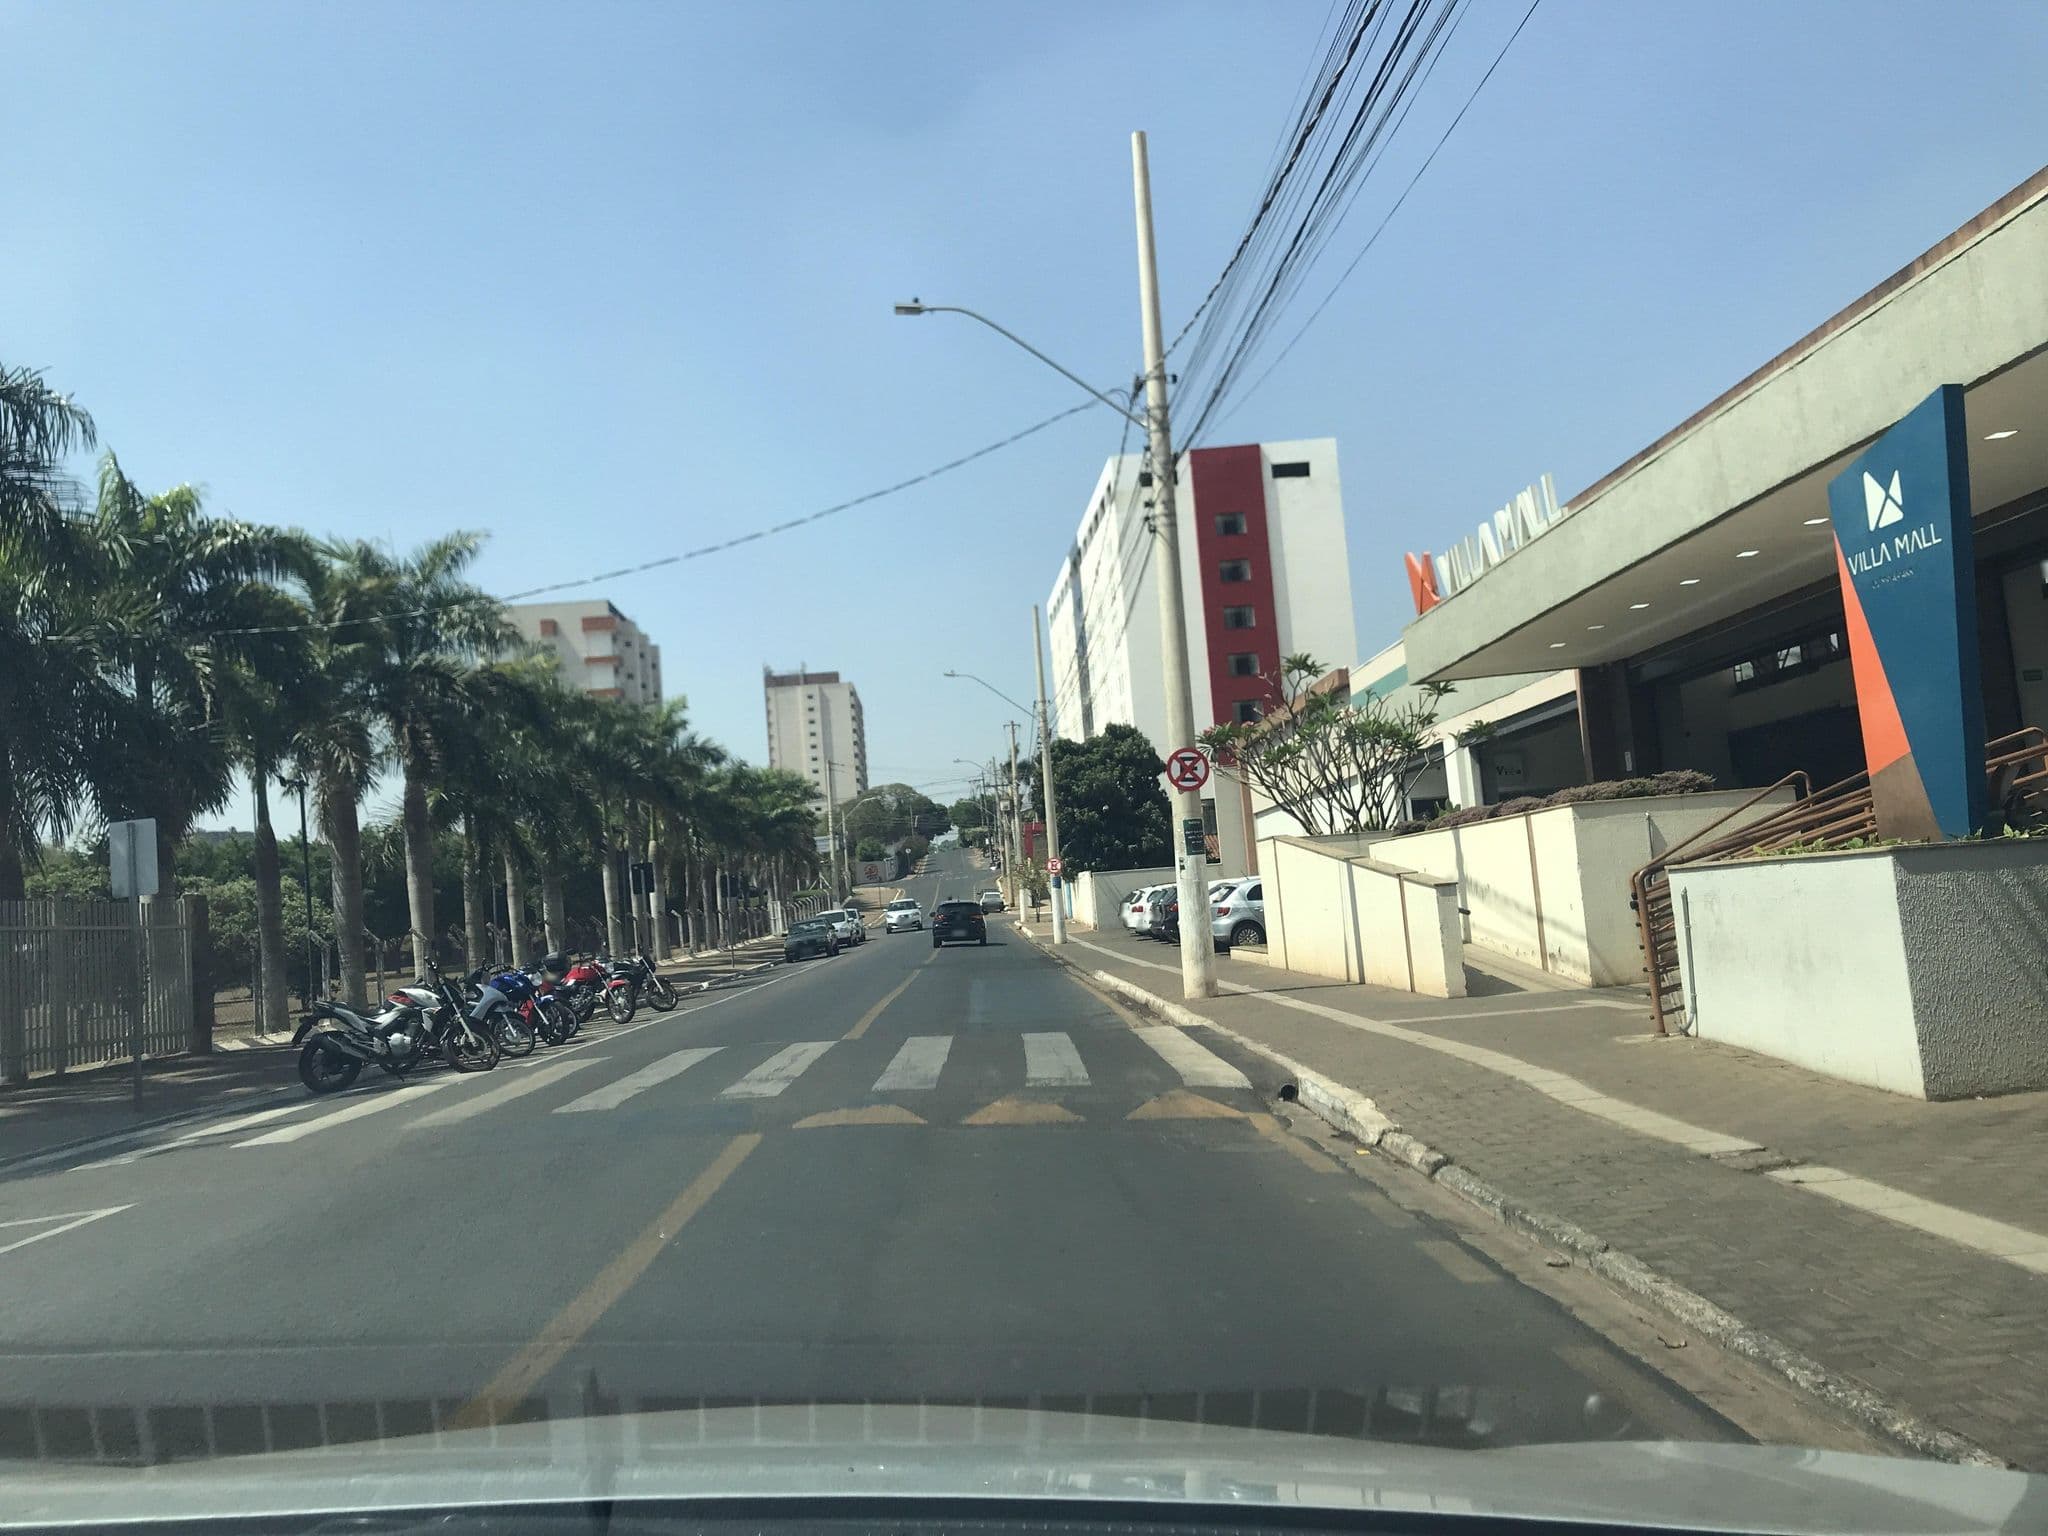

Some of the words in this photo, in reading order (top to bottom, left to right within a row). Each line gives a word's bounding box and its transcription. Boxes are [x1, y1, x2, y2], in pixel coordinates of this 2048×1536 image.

[1436, 522, 1501, 596] VILLA
[1494, 472, 1562, 559] MALL
[1848, 543, 1891, 576] VILLA
[1895, 523, 1942, 558] MALL
